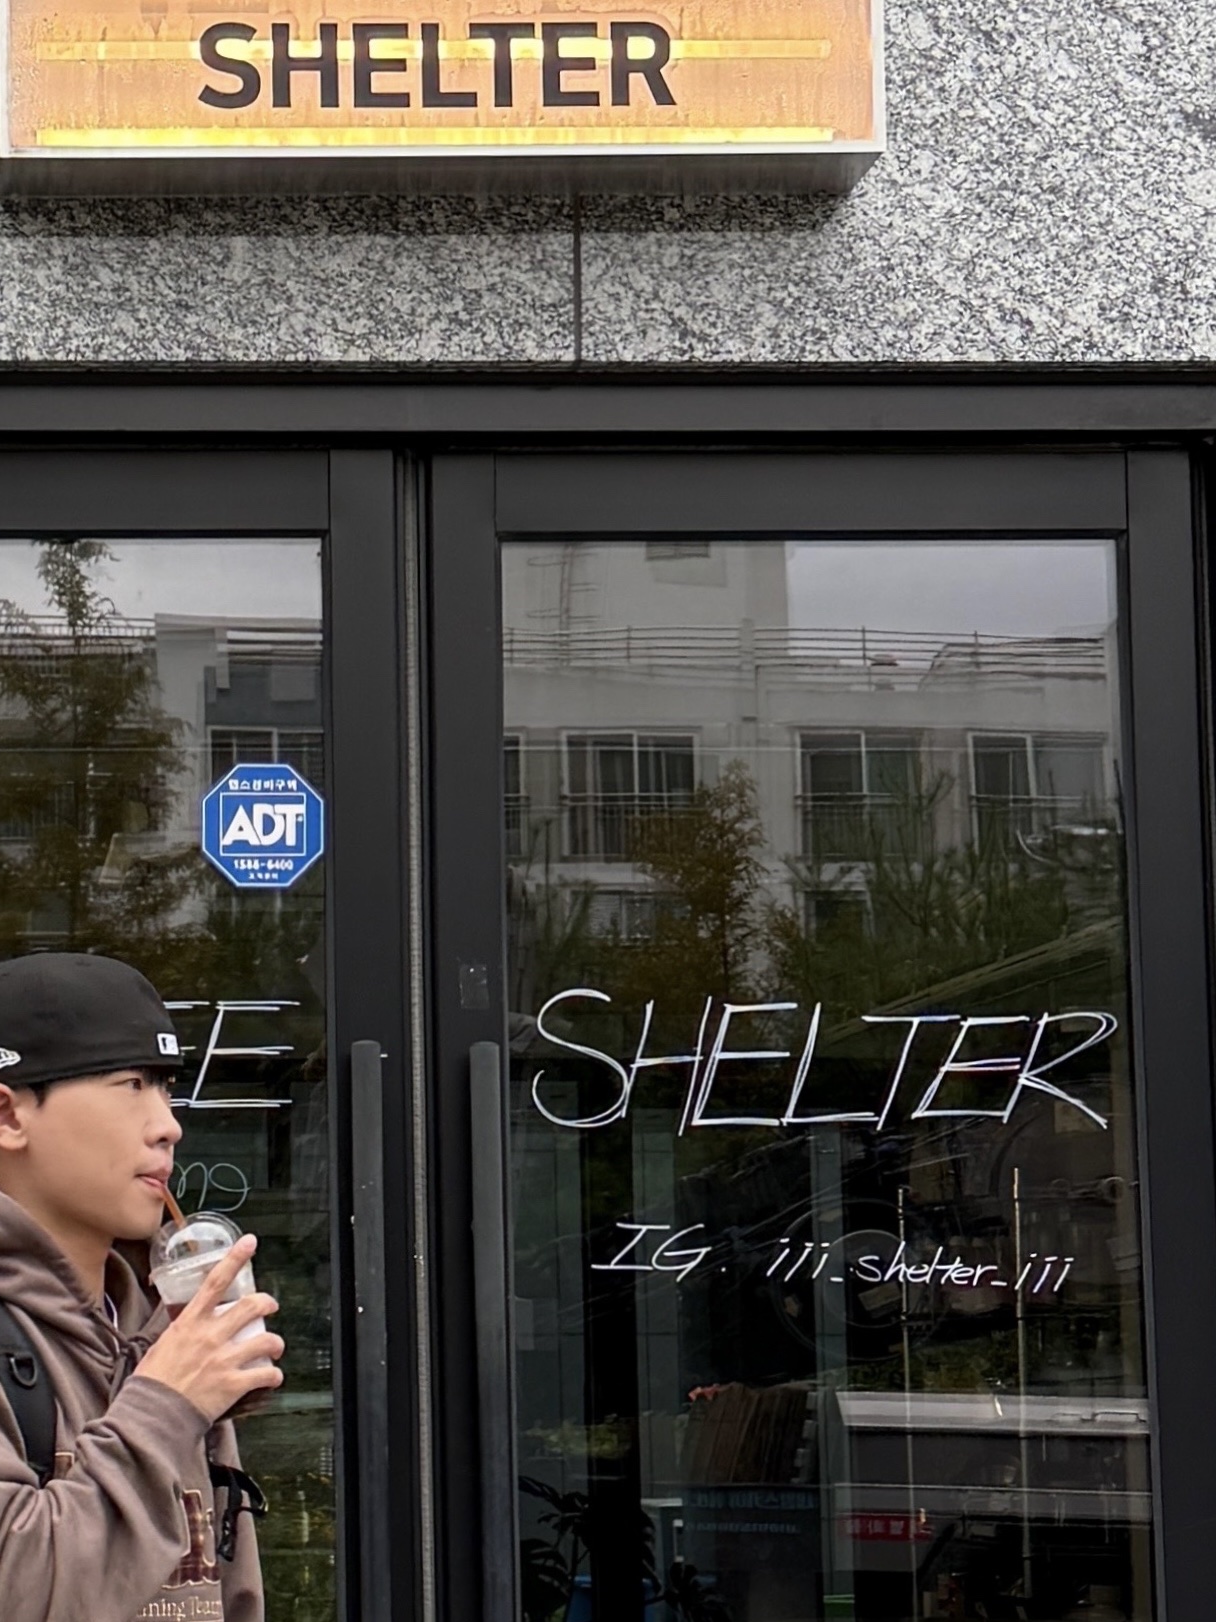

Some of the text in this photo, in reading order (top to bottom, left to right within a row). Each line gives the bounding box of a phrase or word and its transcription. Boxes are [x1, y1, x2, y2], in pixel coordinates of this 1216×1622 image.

[197, 21, 677, 109] SHELTER
[221, 803, 304, 846] ADT
[531, 988, 1118, 1137] SHELTER
